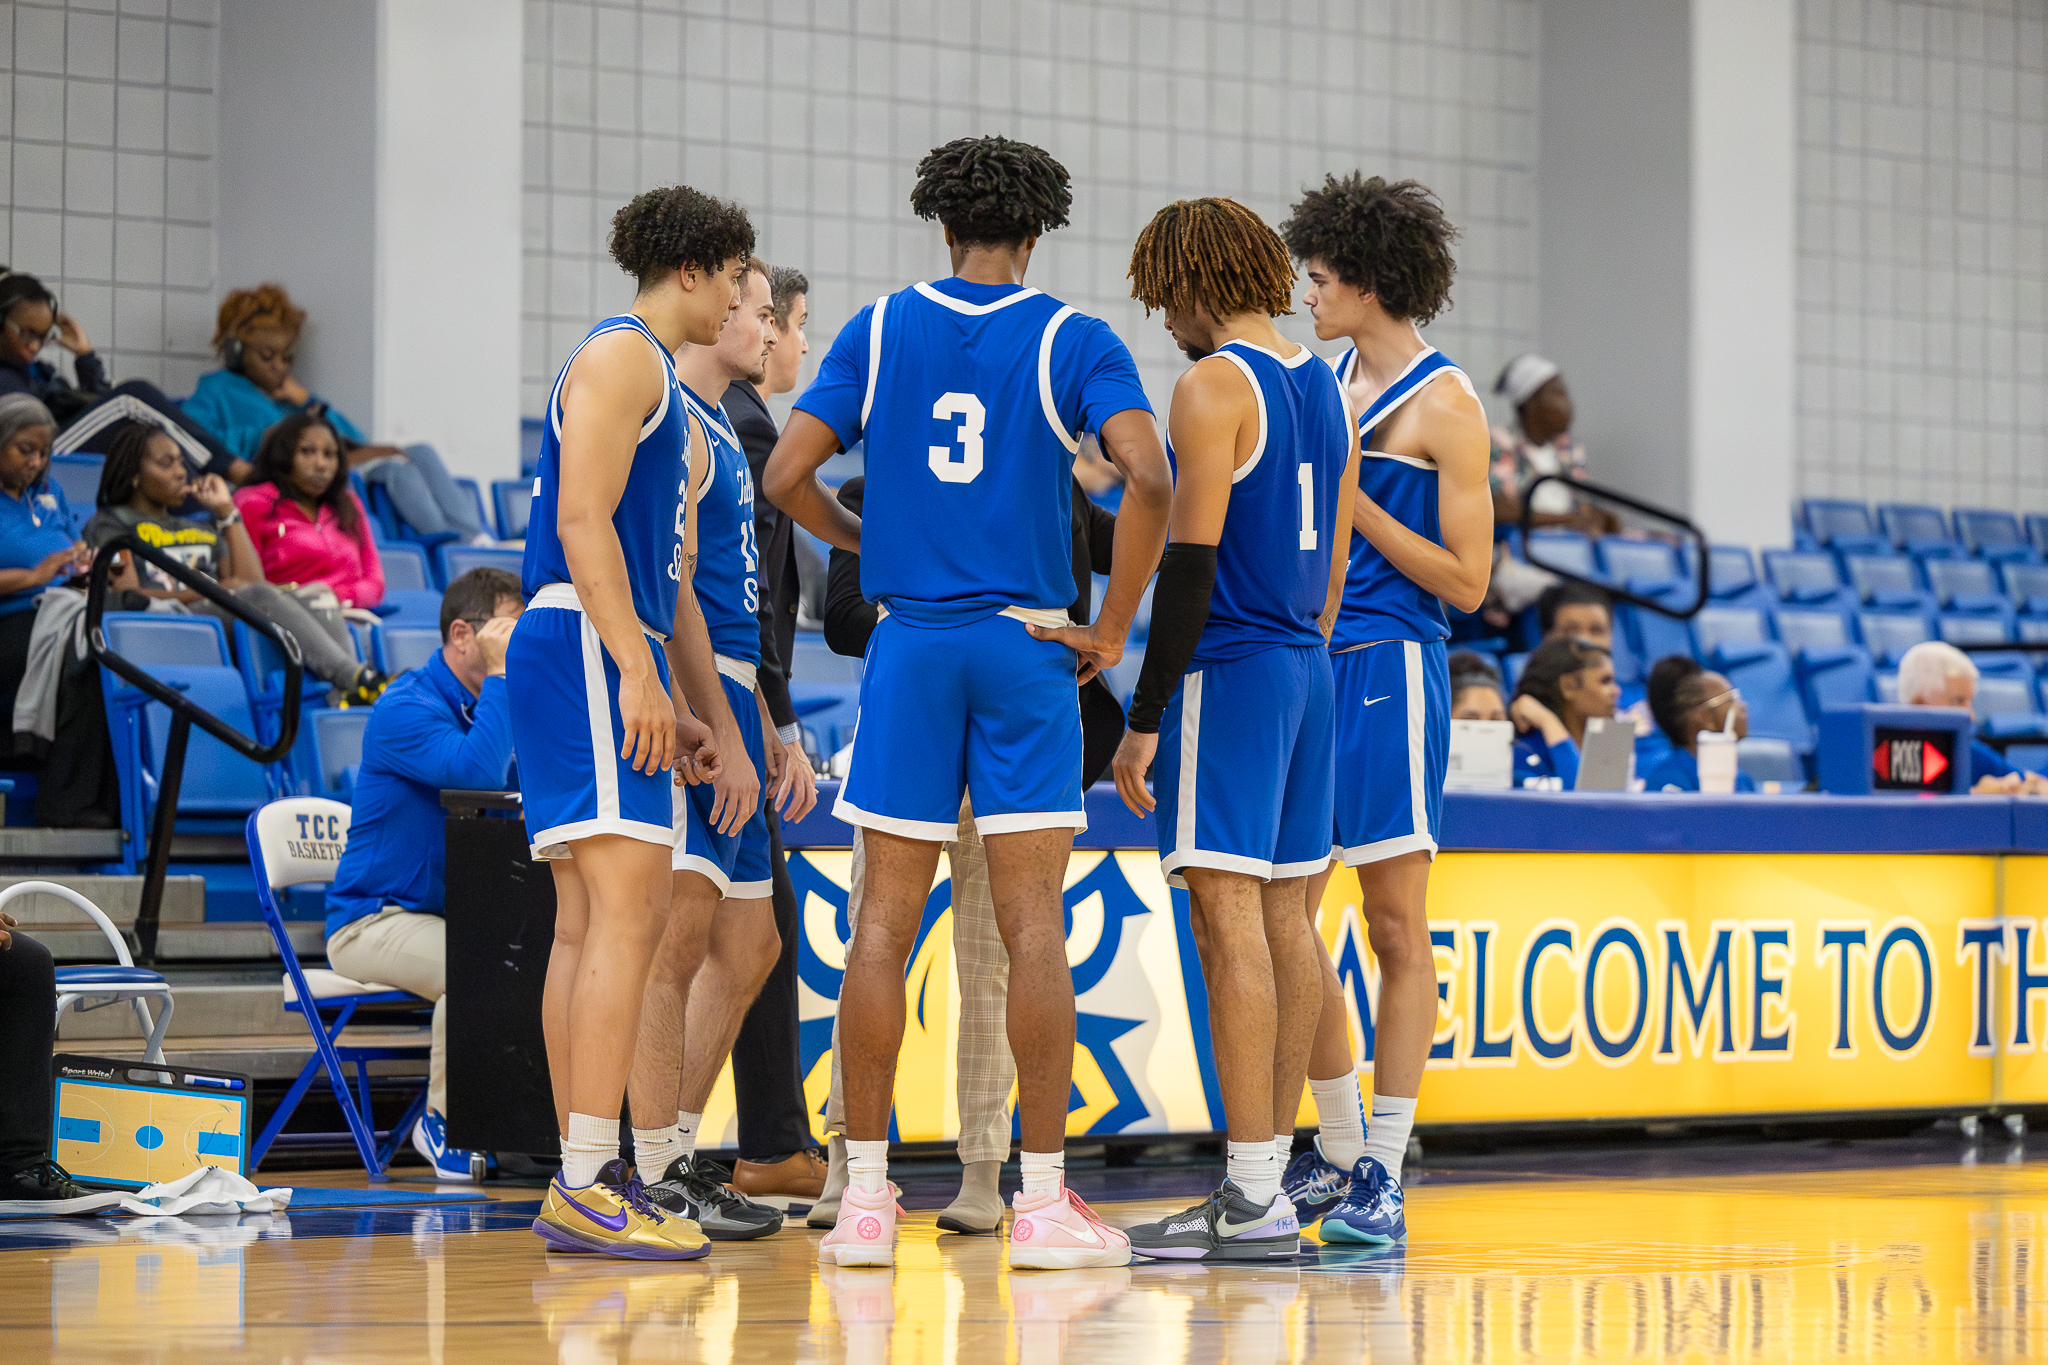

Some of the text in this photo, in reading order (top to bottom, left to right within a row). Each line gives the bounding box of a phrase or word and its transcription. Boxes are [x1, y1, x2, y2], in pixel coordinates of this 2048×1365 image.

[928, 391, 986, 484] 3
[1297, 462, 1318, 551] 1
[1890, 739, 1922, 783] POSS
[295, 813, 339, 841] TCC
[1816, 916, 1936, 1061] TO
[61, 1066, 87, 1078] Sport
